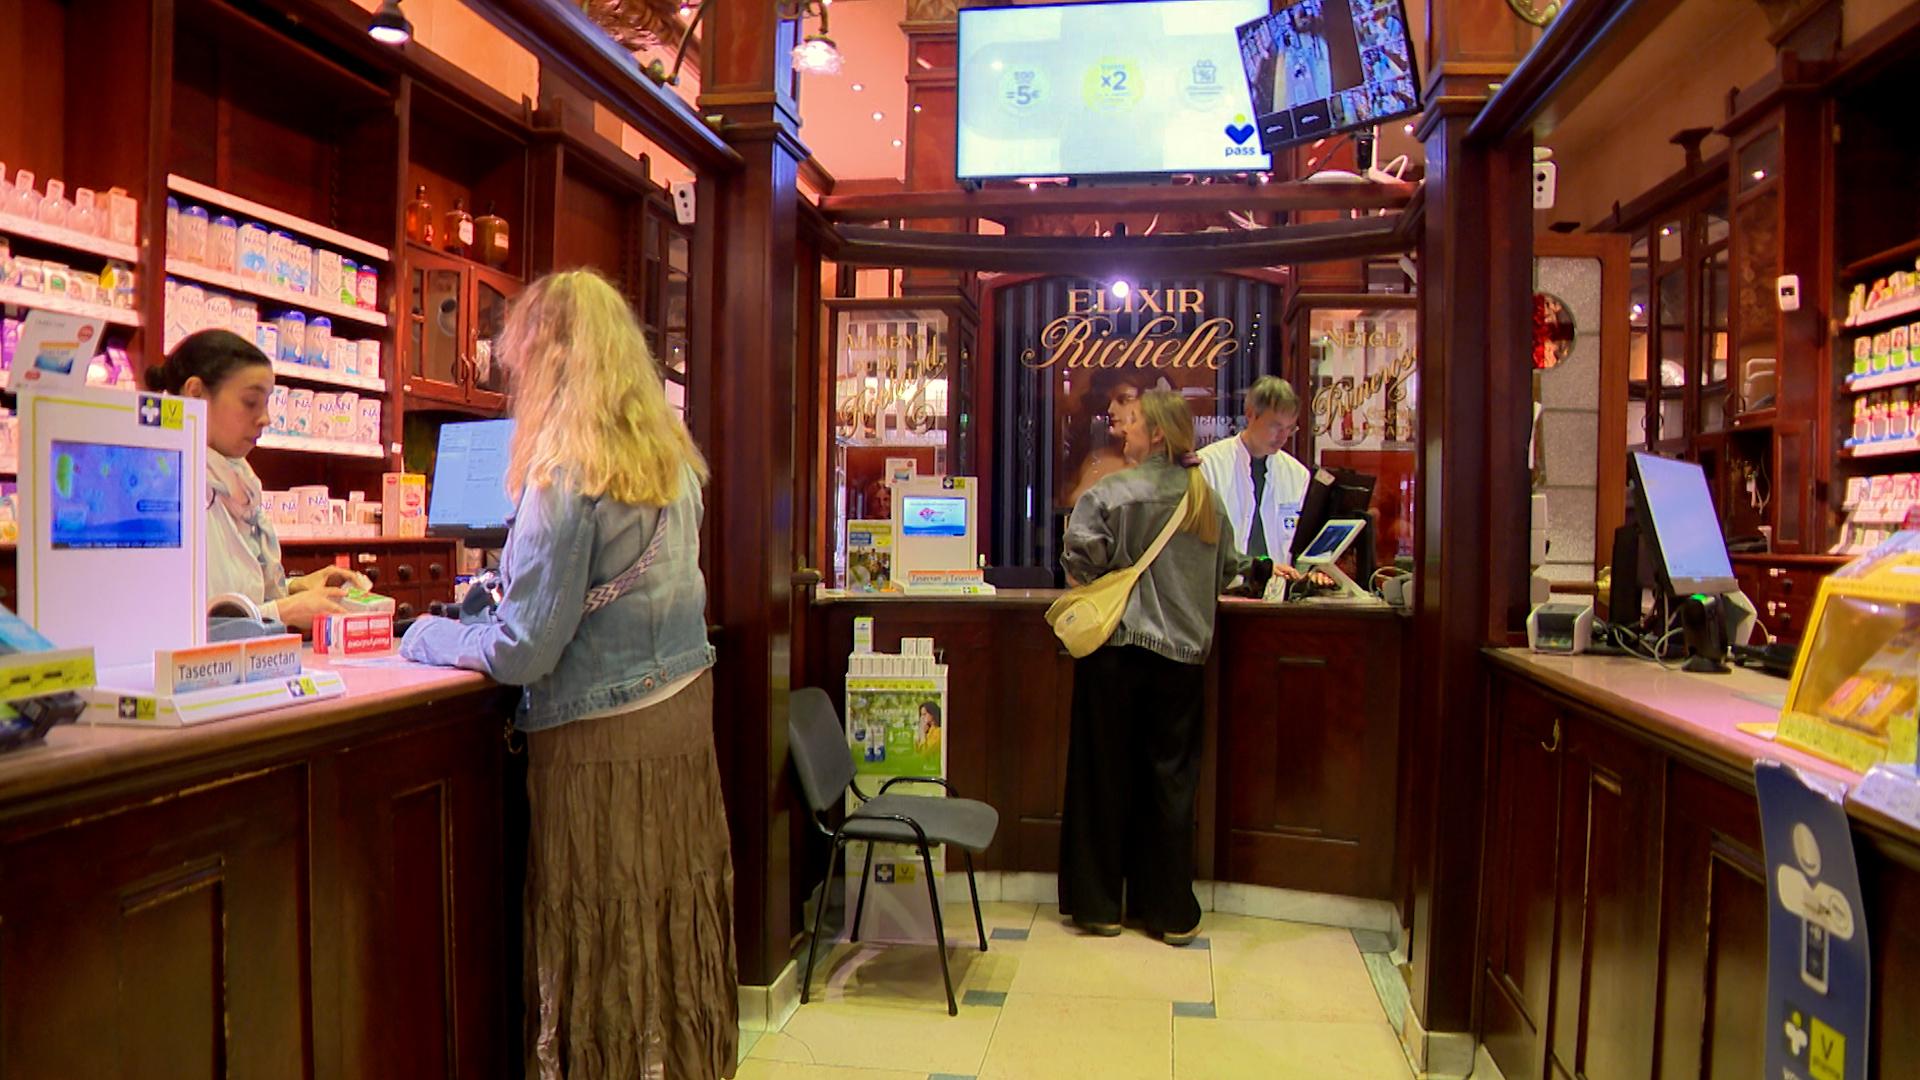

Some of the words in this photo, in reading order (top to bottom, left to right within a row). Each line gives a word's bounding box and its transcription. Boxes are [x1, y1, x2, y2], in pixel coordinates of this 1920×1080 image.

[1225, 146, 1256, 157] pass
[1067, 288, 1205, 314] ELIXIR
[1020, 315, 1239, 371] Richelle
[1325, 328, 1403, 349] NEIGE
[178, 660, 232, 680] Tasectan
[248, 652, 295, 670] Tasectan
[1821, 1033, 1834, 1061] V
